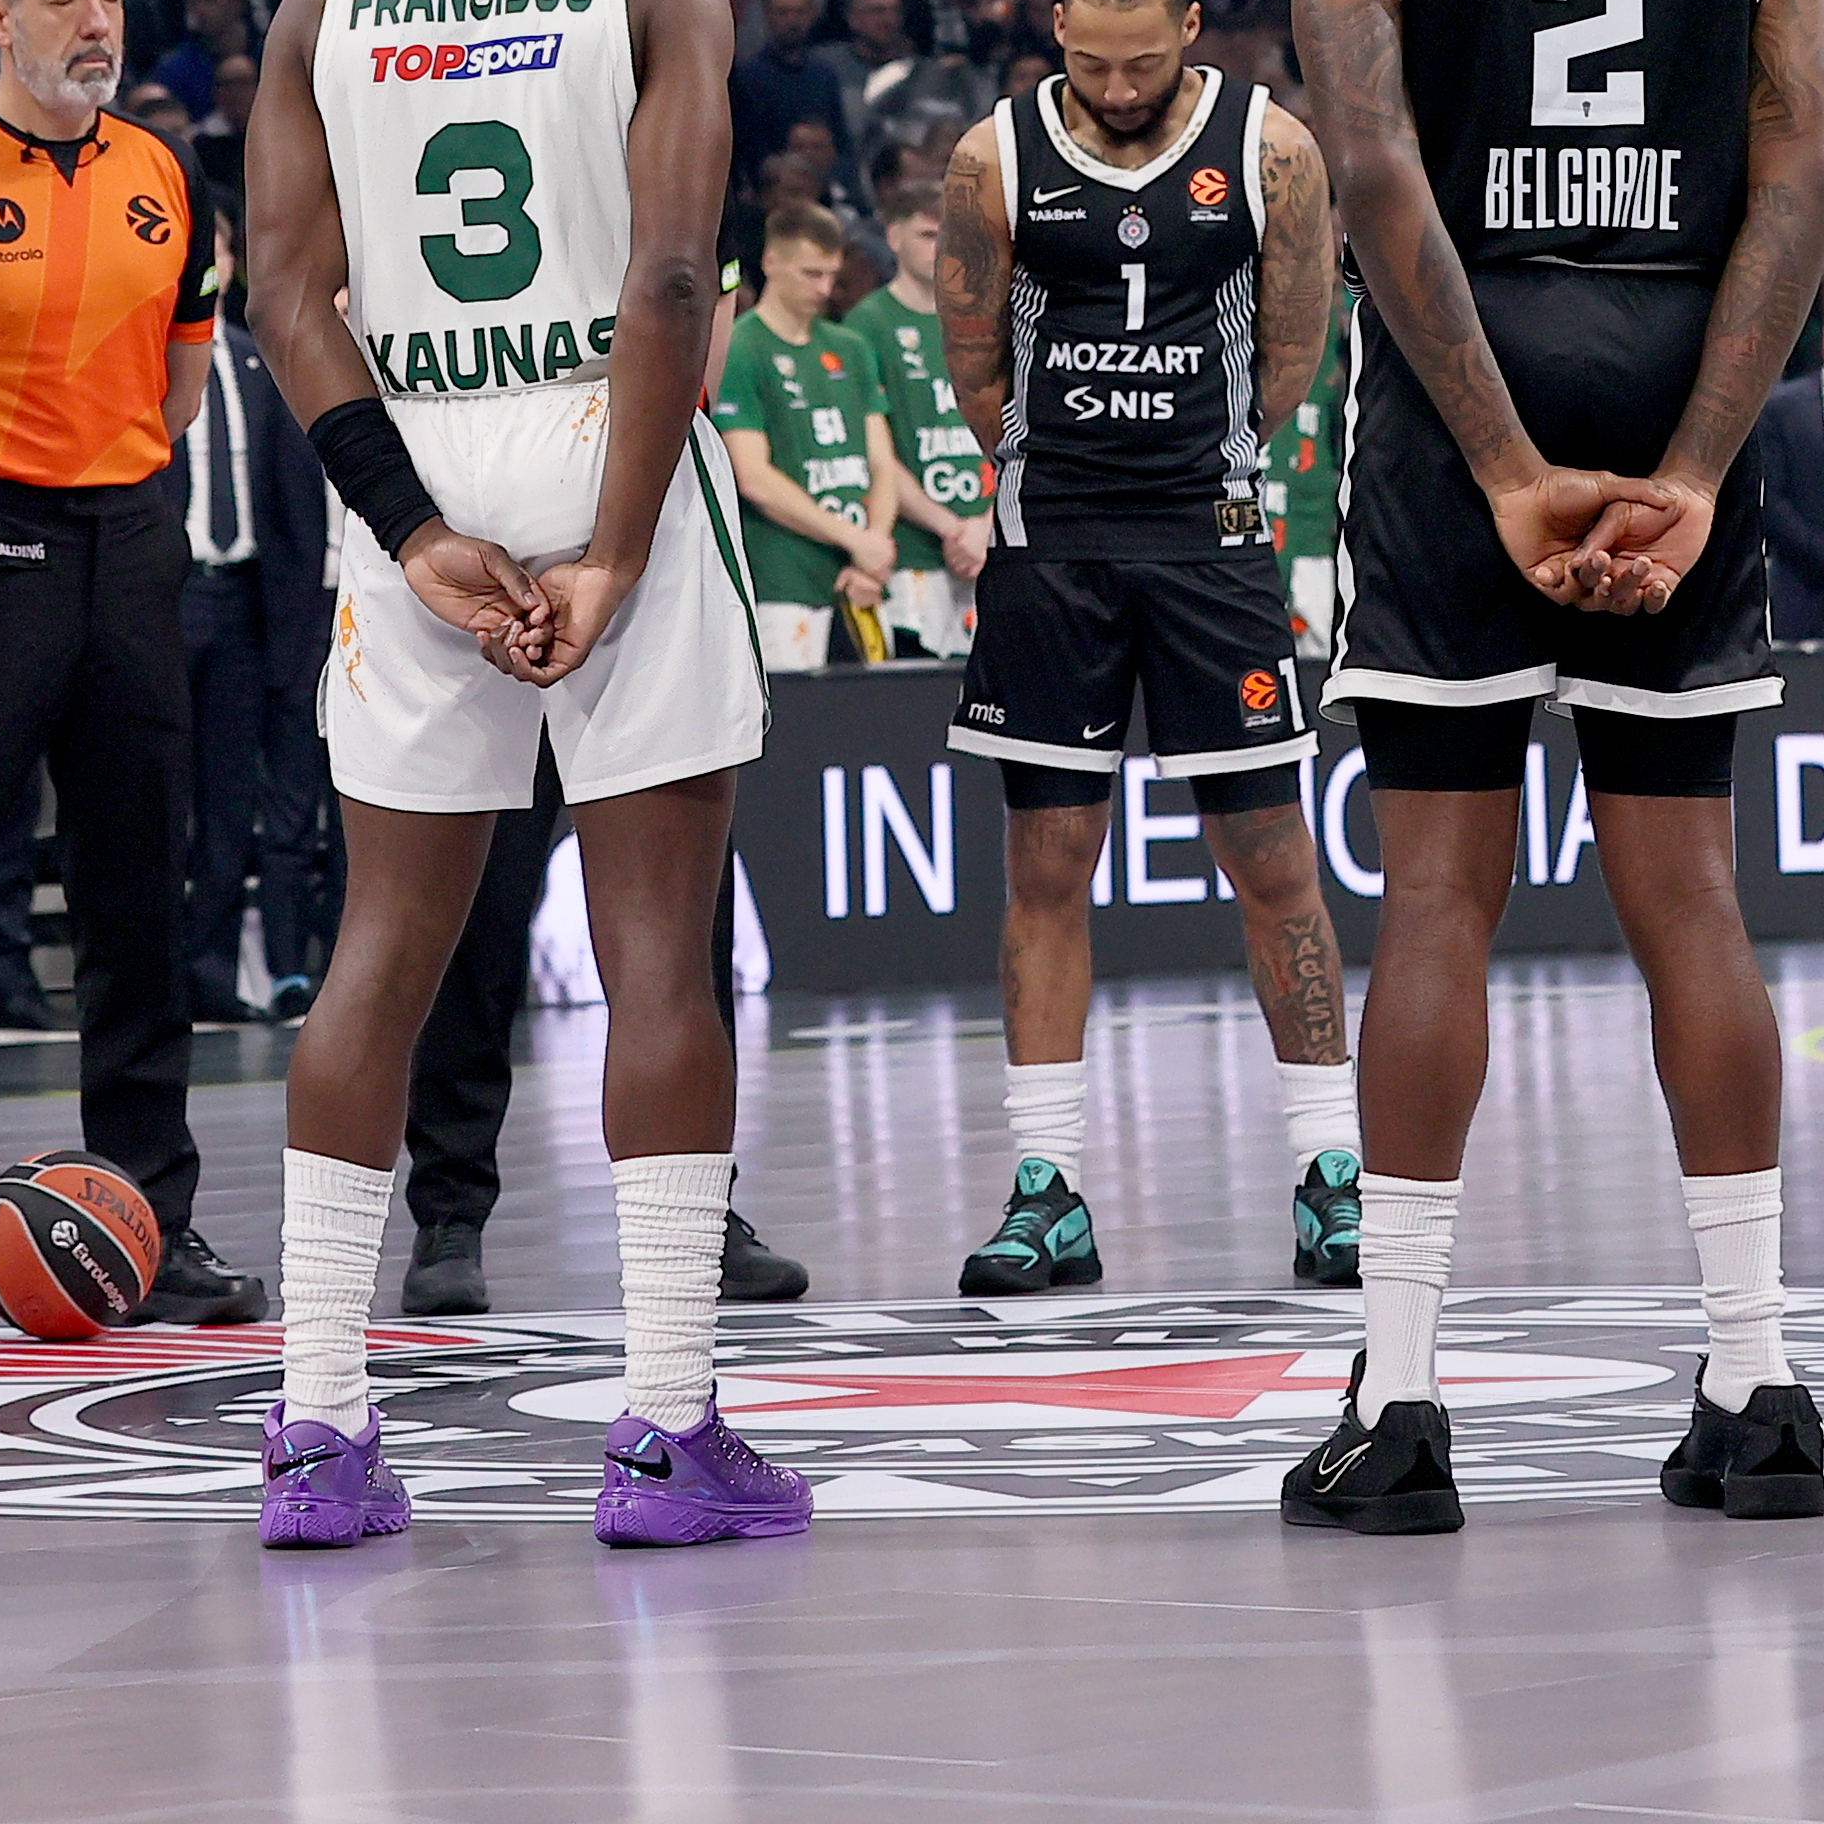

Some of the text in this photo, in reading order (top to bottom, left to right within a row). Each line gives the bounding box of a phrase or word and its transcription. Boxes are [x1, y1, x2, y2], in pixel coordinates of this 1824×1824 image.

[370, 33, 563, 84] TOPsport
[414, 119, 543, 304] 3
[1484, 146, 1683, 231] BELGRADE
[1120, 263, 1146, 331] 1
[366, 314, 617, 393] KAUNAS
[1045, 342, 1205, 375] MOZZART
[1110, 390, 1175, 421] NIS
[968, 702, 1006, 725] mts
[1278, 657, 1306, 732] 1
[822, 764, 955, 918] IN
